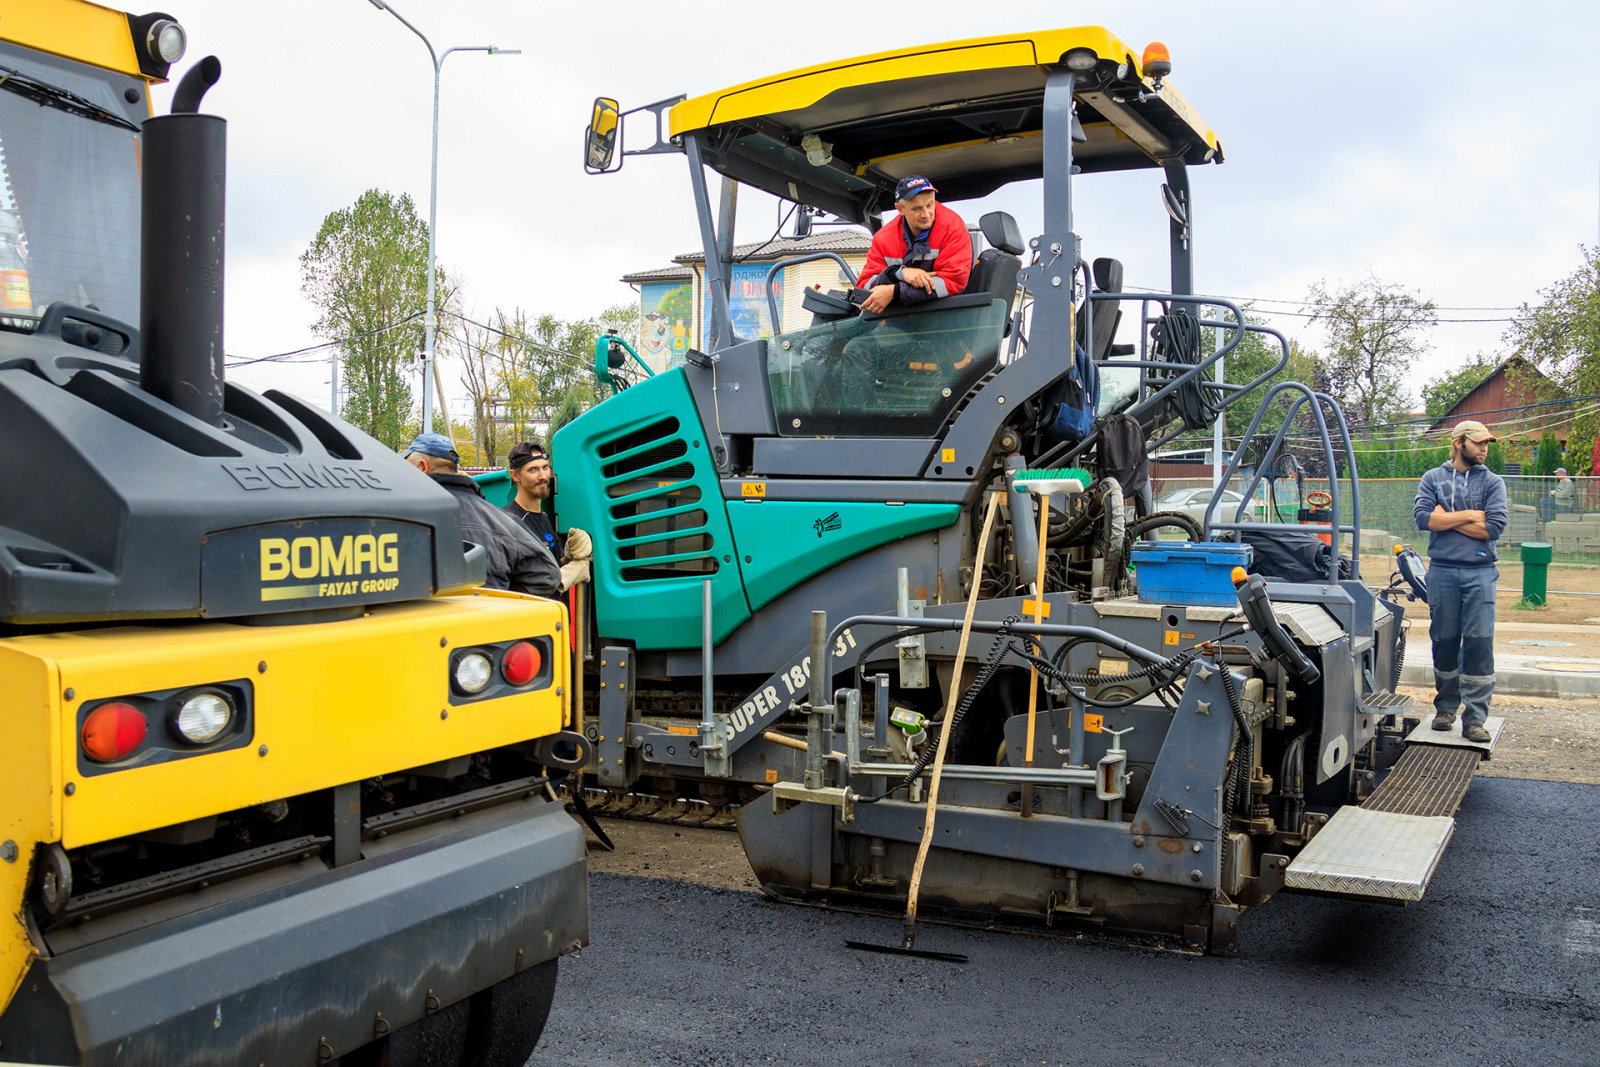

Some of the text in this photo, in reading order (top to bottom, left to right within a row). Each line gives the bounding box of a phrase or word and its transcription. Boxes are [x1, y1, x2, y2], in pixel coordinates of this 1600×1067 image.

[221, 463, 392, 491] BOMAG
[260, 533, 399, 581] BOMAG
[318, 577, 399, 597] FAYAT GROUP
[725, 685, 782, 741] SUPER
